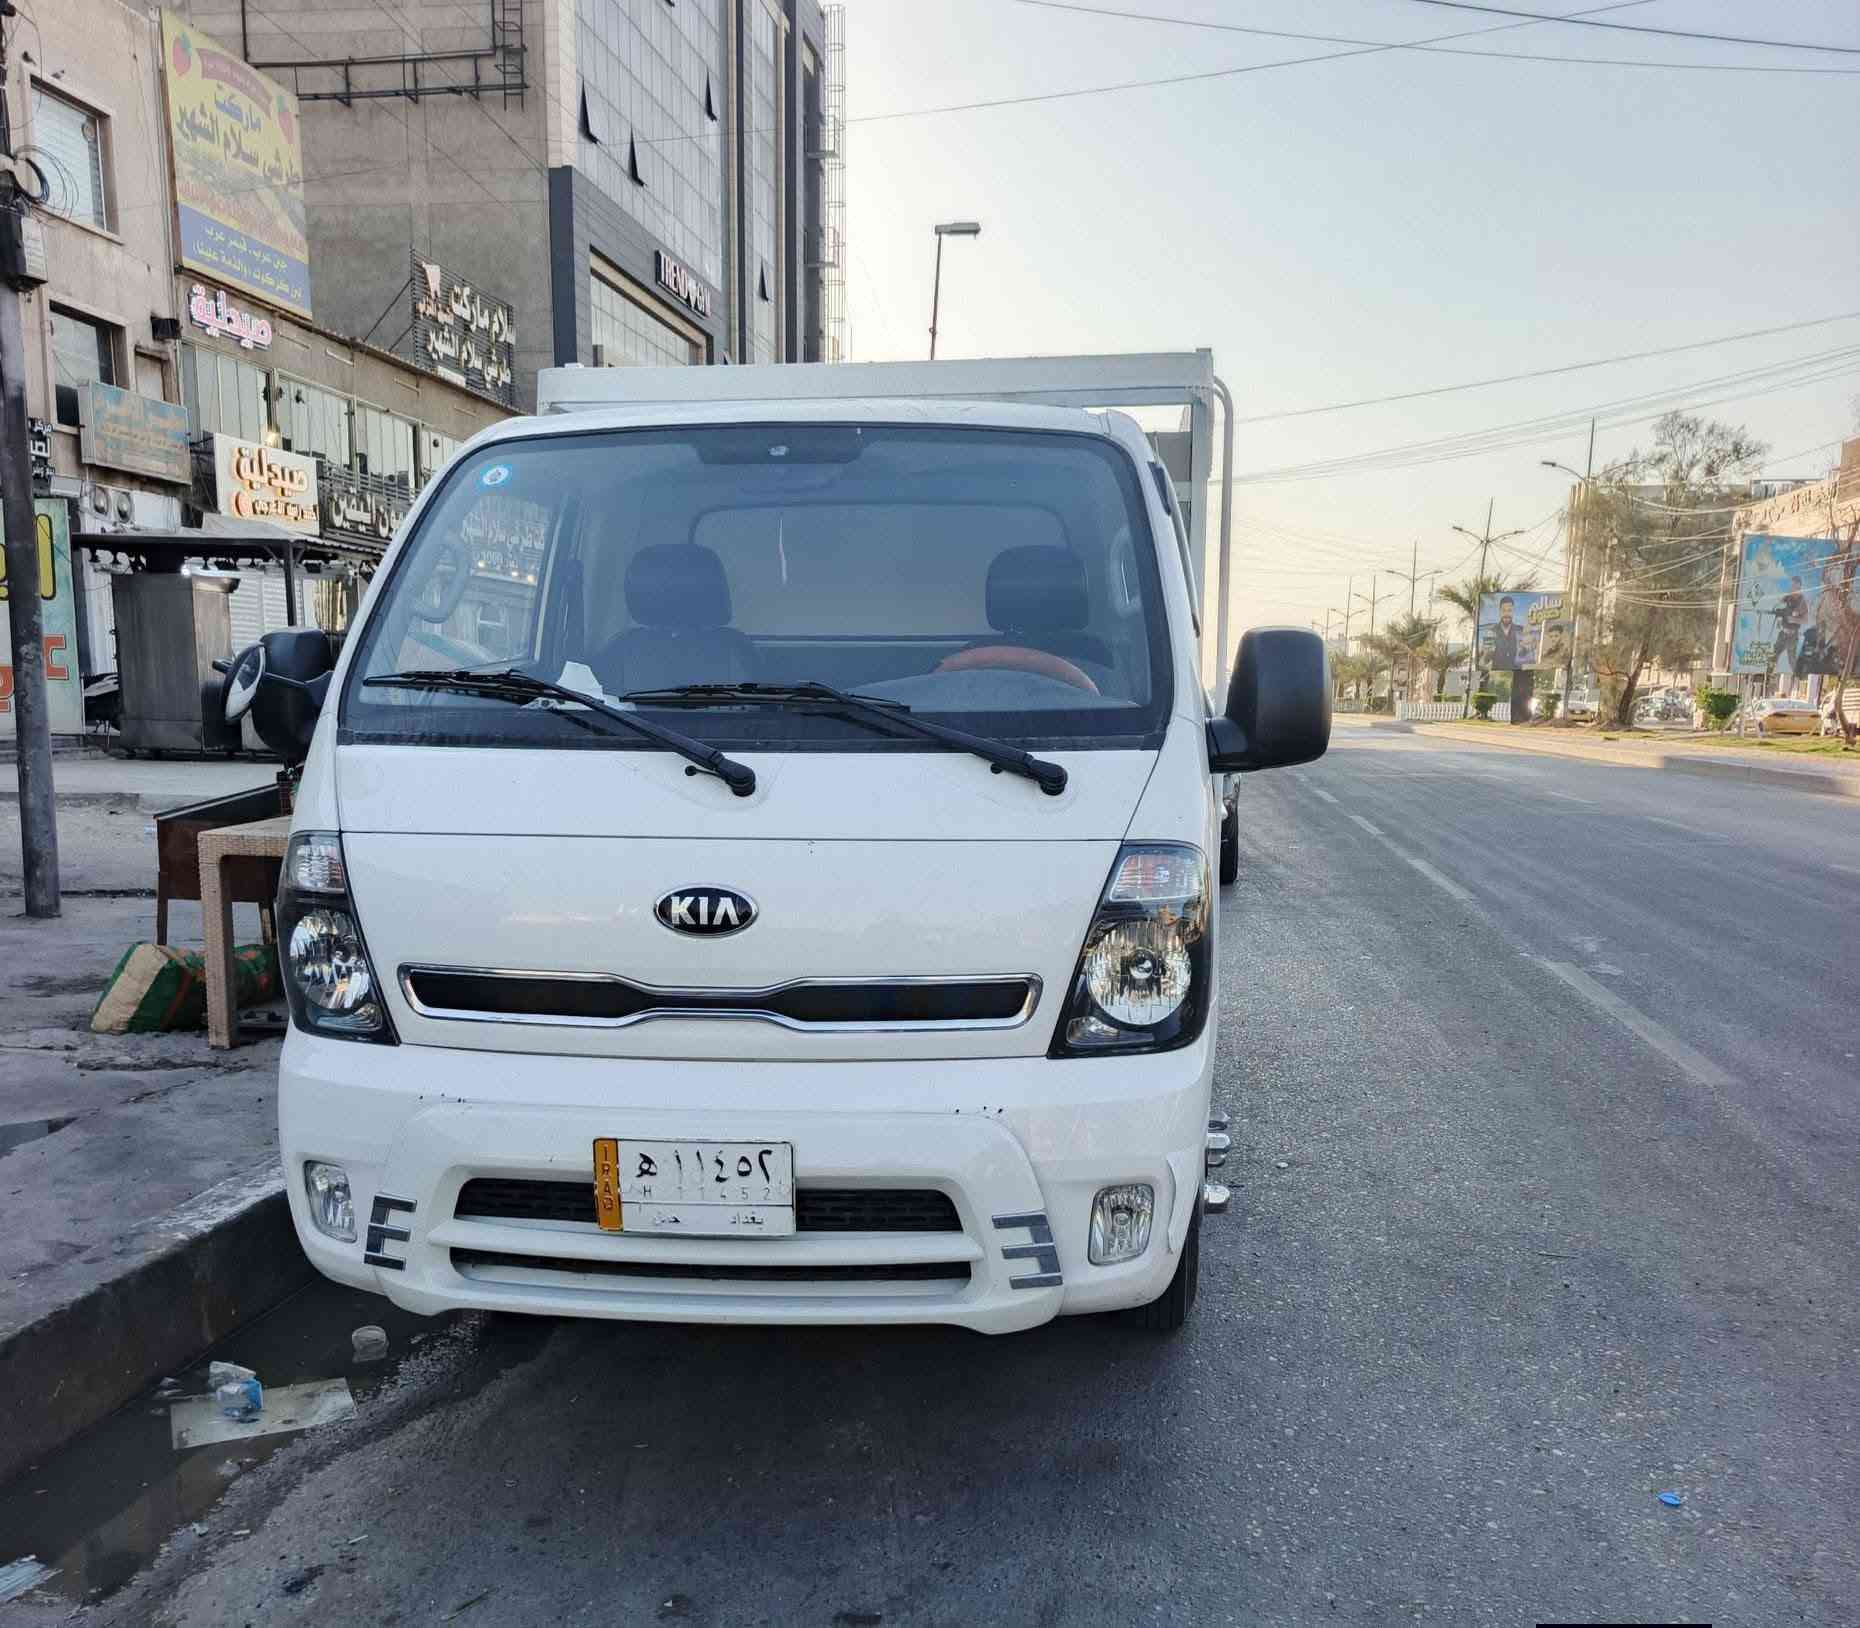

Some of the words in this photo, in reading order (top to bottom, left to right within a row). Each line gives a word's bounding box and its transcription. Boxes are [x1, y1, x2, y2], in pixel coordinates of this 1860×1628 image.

[660, 251, 688, 299] TREND
[190, 284, 272, 350] صيدلية
[451, 284, 490, 333] ماركت
[491, 304, 516, 345] سلام
[426, 325, 459, 361] الشهير
[461, 339, 483, 369] سلام
[232, 447, 309, 497] صيدلية
[671, 896, 740, 925] KIA
